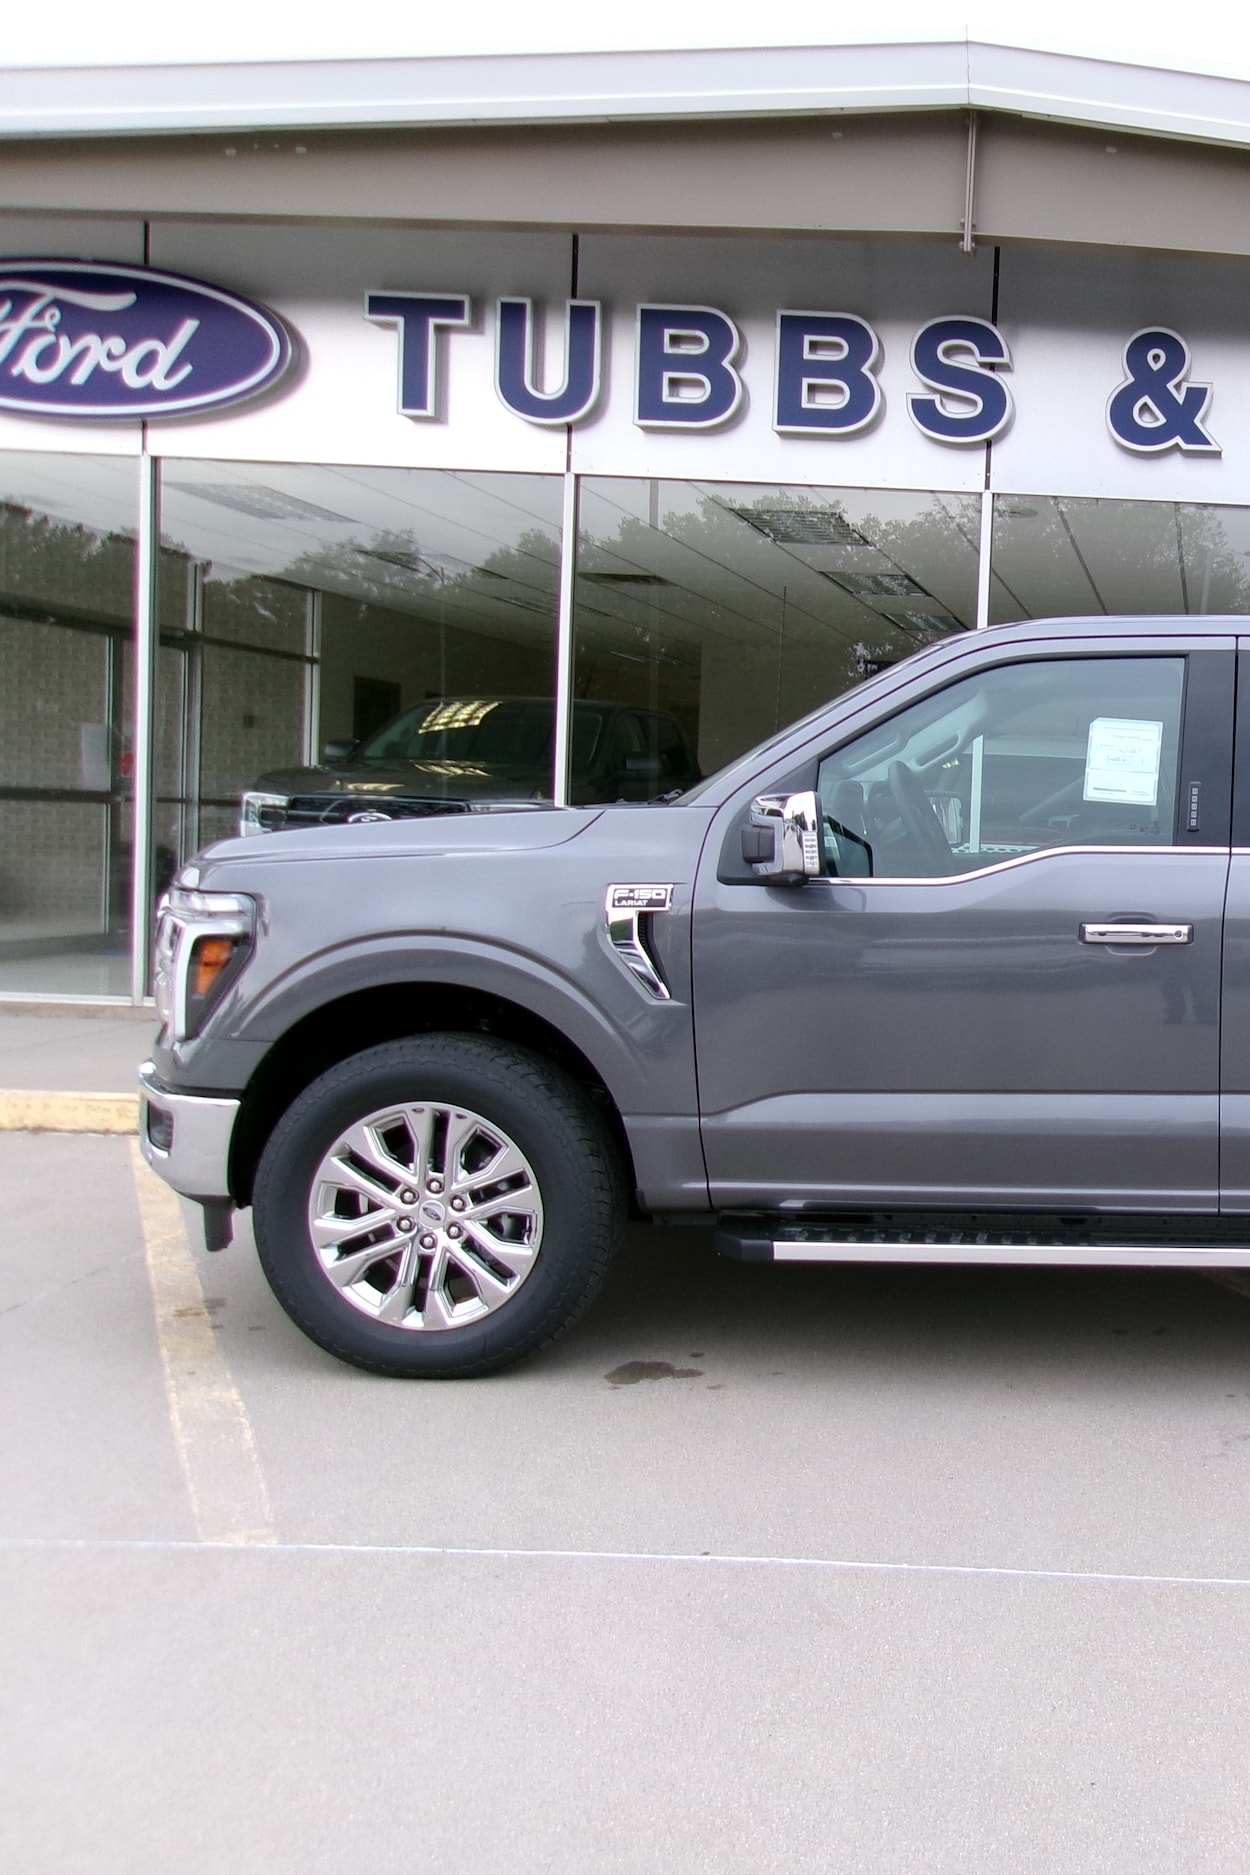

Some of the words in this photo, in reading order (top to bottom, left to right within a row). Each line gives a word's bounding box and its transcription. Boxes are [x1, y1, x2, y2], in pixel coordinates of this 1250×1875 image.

[0, 280, 200, 391] Ford
[364, 290, 1012, 445] TUBBS
[1105, 326, 1222, 455] &
[613, 888, 667, 900] F-150
[614, 899, 649, 907] LARIAT
